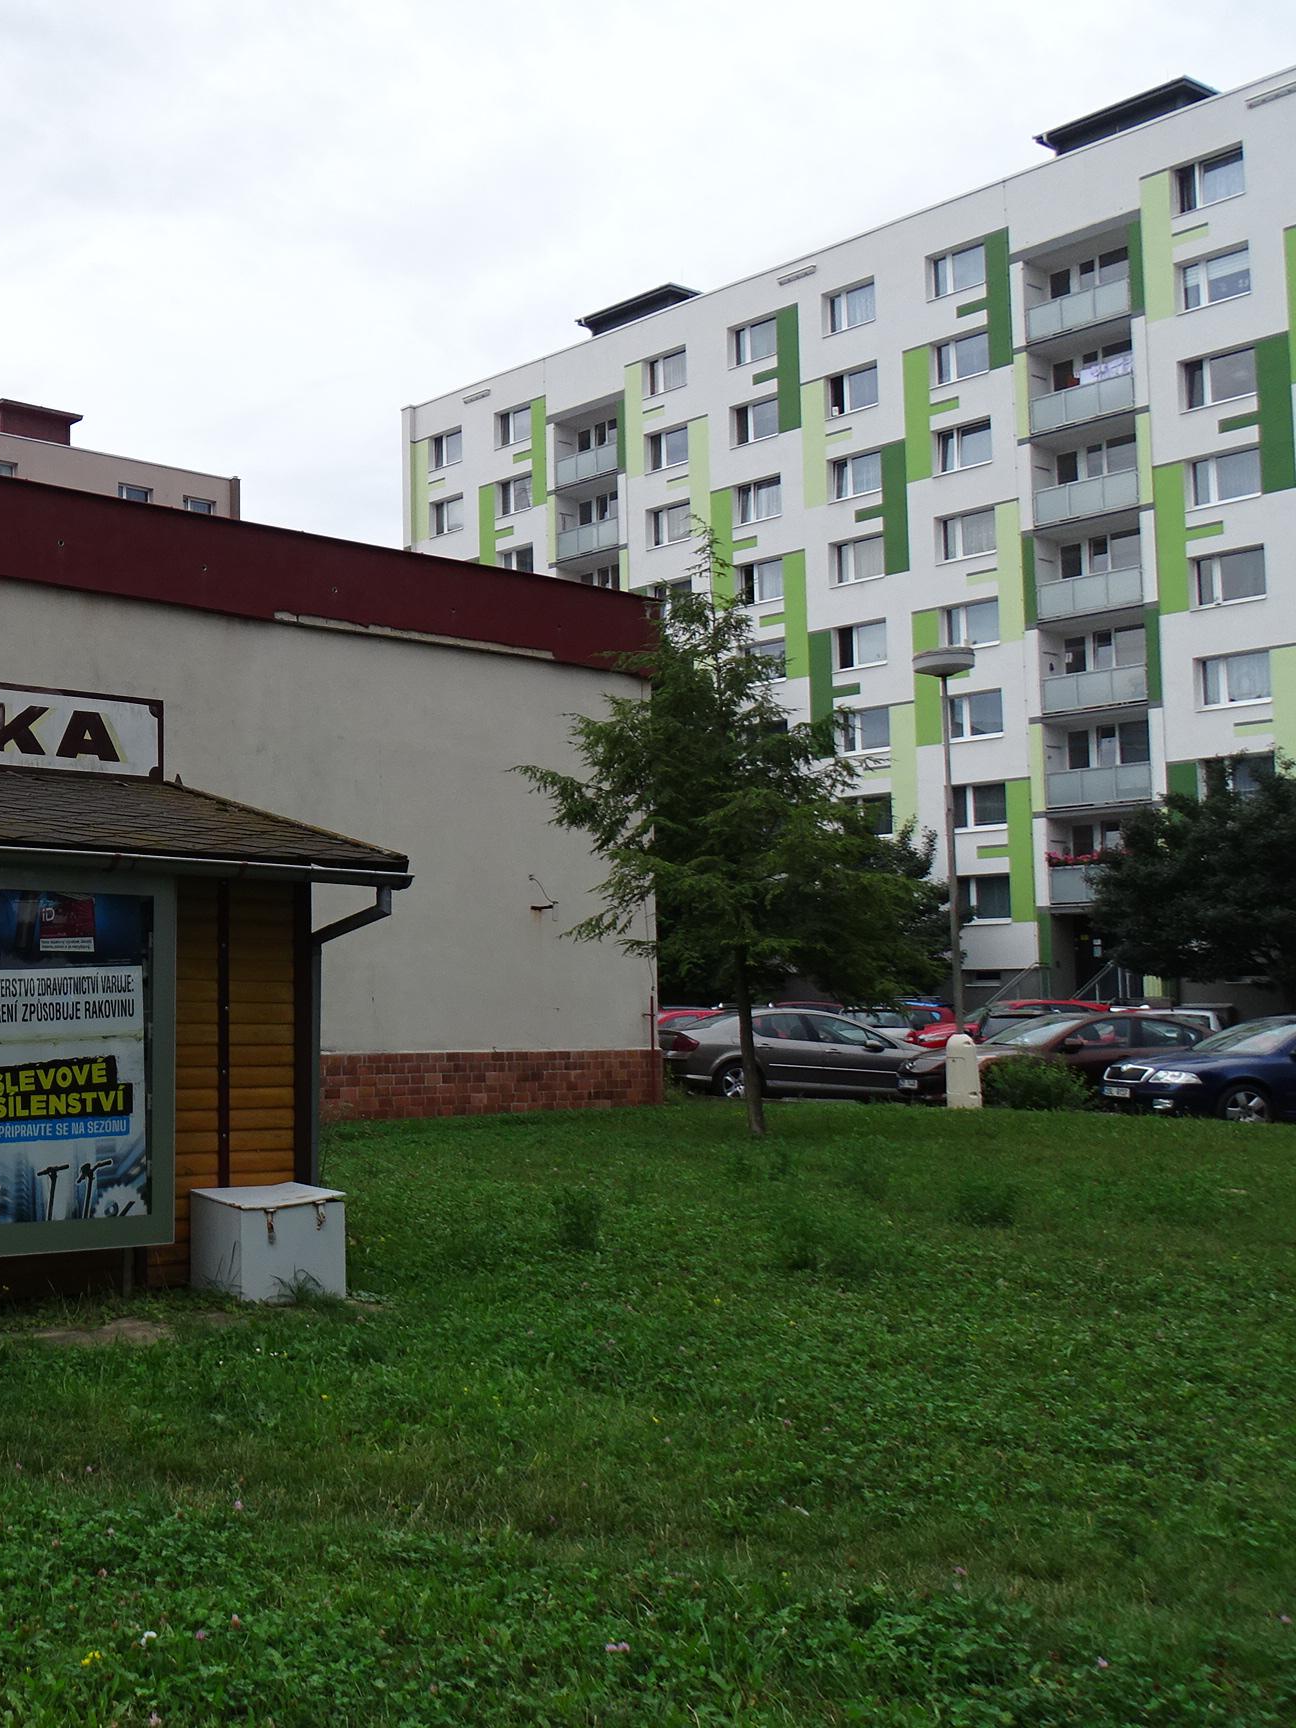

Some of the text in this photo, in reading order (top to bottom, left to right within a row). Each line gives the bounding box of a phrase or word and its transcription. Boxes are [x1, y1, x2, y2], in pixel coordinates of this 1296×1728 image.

[37, 972, 99, 997] ZDRAVOTNICTVÍ
[101, 974, 134, 994] VARUJE:
[21, 998, 81, 1022] ZPŮSOBUJE
[84, 998, 135, 1019] RAKOVINU
[55, 1122, 69, 1136] SE
[71, 1121, 85, 1135] NA
